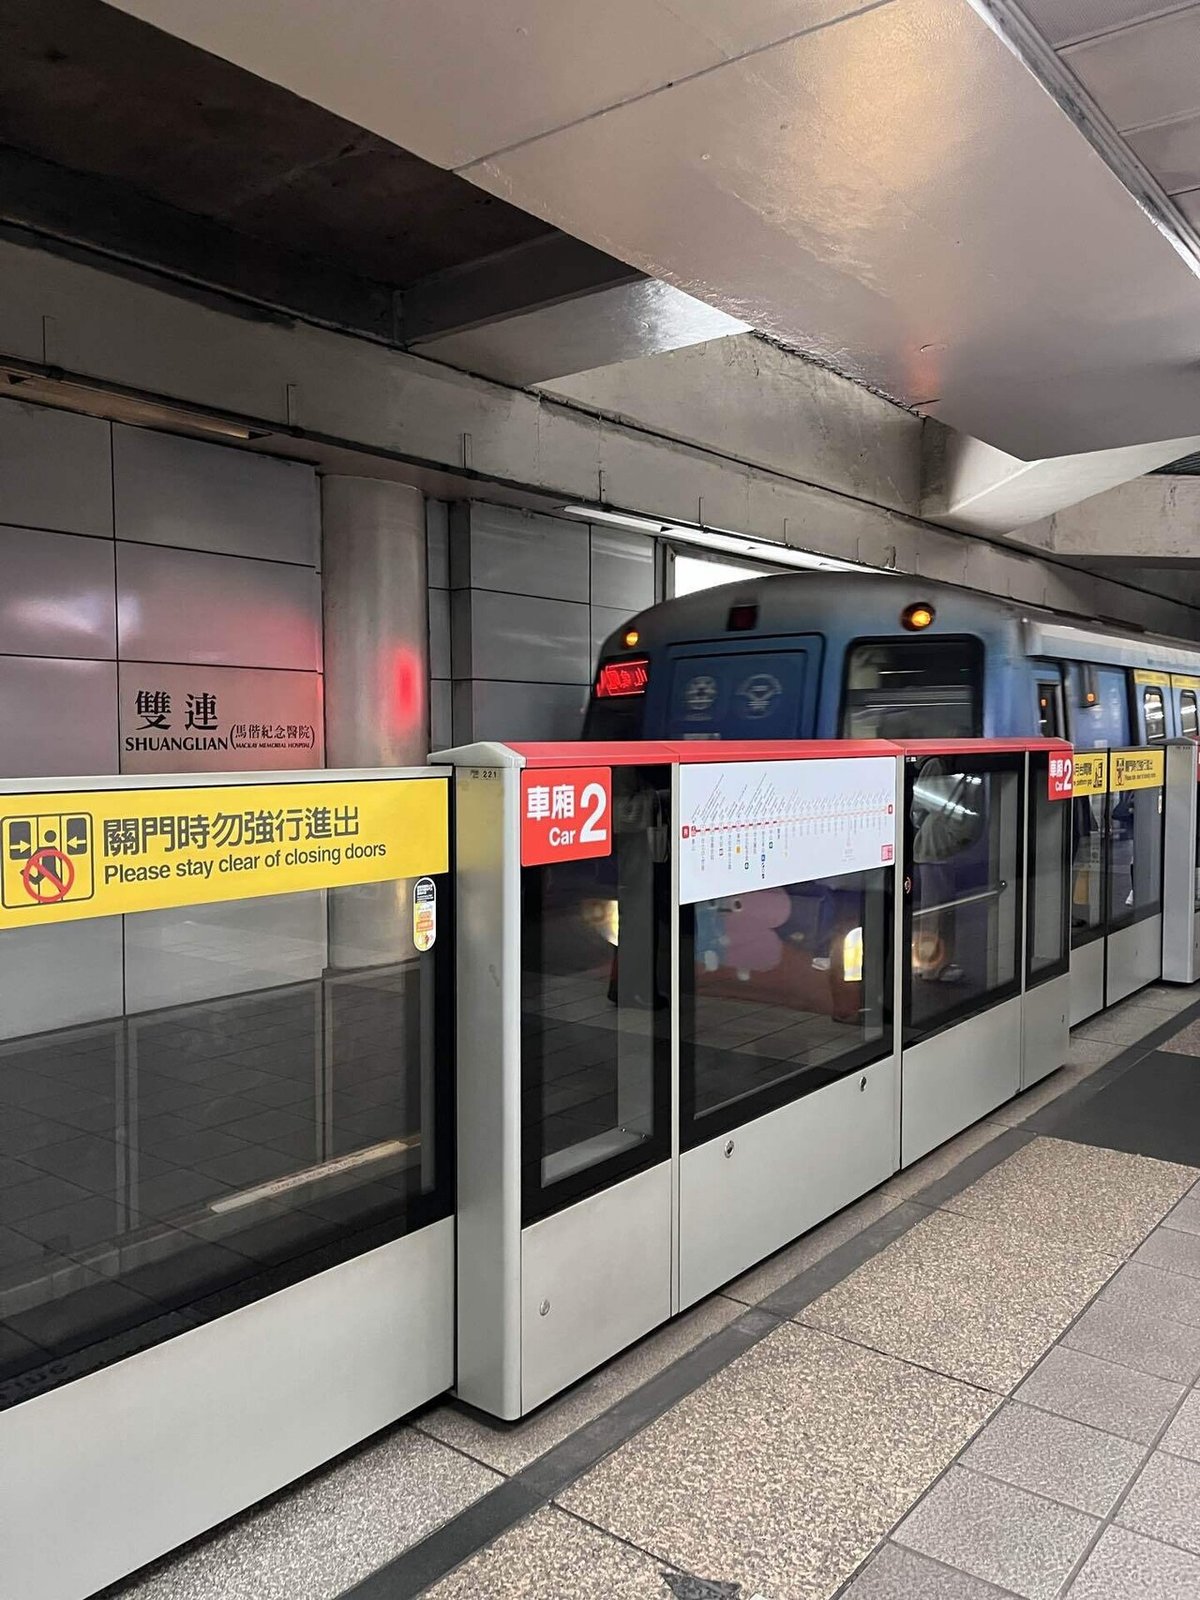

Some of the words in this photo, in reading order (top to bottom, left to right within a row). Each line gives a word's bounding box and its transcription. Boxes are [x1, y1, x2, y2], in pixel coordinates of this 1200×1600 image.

[135, 690, 218, 730] 雙連
[125, 736, 228, 751] SHUANGLIAN
[482, 770, 497, 778] 221
[1063, 758, 1072, 791] 2
[526, 783, 575, 821] 車廂
[579, 782, 607, 843] 2
[103, 805, 360, 857] 關門時勿強行進出
[548, 826, 576, 847] Car
[105, 862, 171, 884] Please
[176, 856, 213, 879] stay
[219, 853, 260, 872] clear
[265, 850, 281, 866] of
[285, 846, 341, 865] closing
[345, 842, 386, 860] doors
